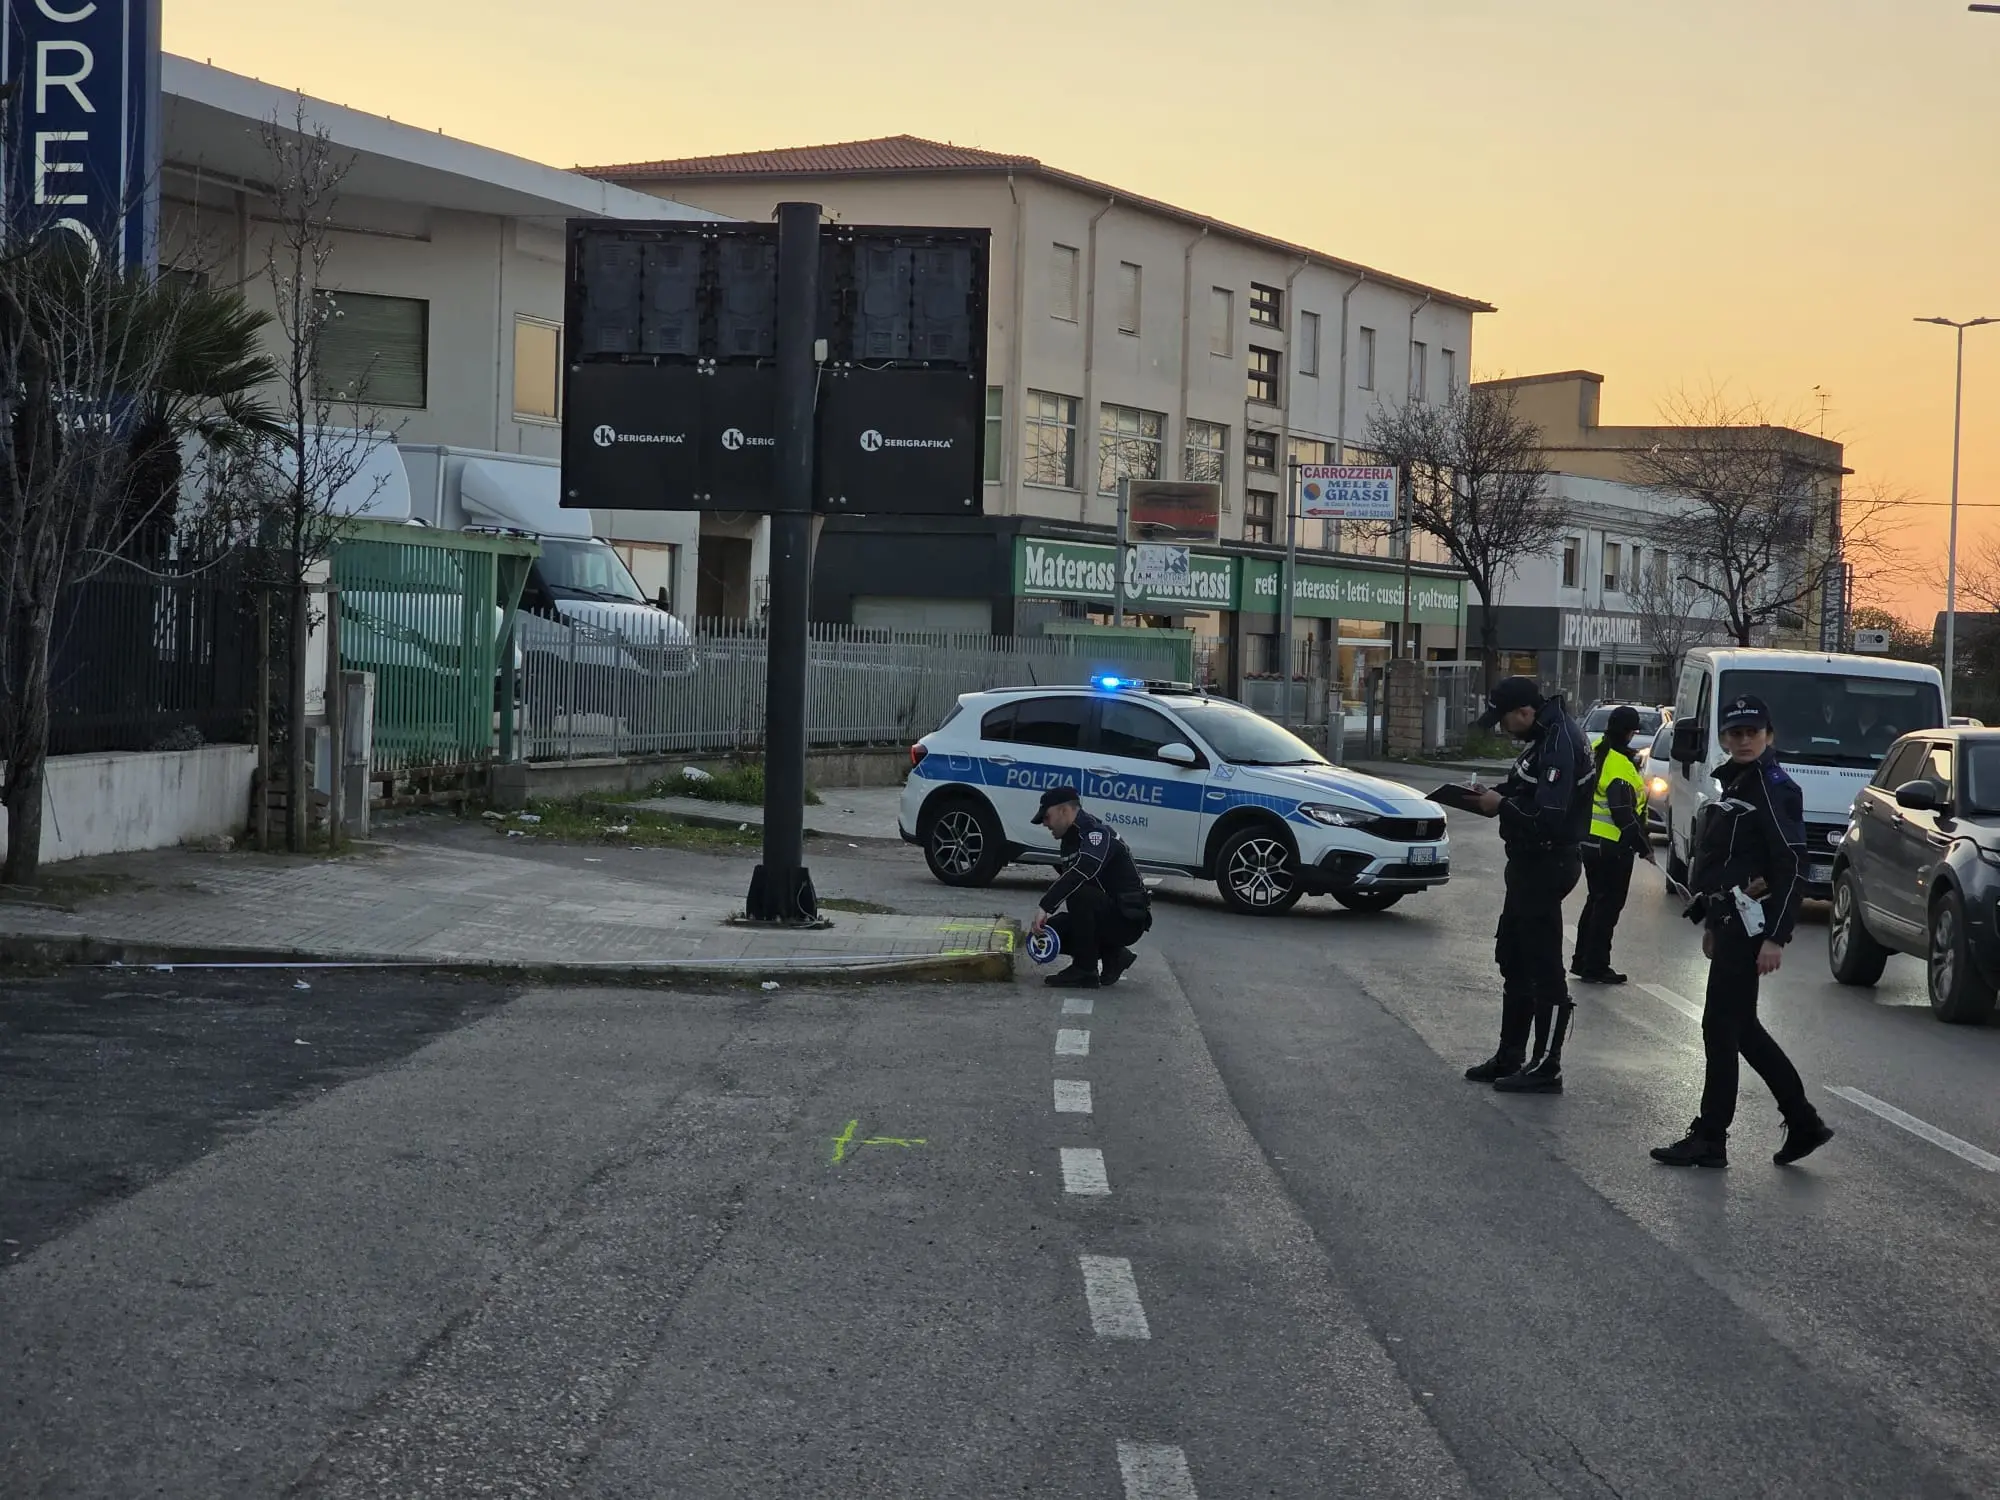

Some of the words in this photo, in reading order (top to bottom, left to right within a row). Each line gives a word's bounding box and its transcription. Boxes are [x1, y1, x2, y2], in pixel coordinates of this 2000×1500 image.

[746, 437, 775, 446] SERIG
[1304, 467, 1393, 479] CARROZZERIA
[1325, 489, 1389, 501] GRASSI
[1024, 546, 1115, 591] Materass
[1255, 573, 1277, 595] reti
[1293, 579, 1339, 601] aterassi
[1347, 580, 1370, 603] letti
[1418, 588, 1459, 611] poltrone
[1006, 769, 1074, 788] POLIZIA
[1088, 778, 1164, 804] LOCALE
[1105, 812, 1149, 827] SASSARI
